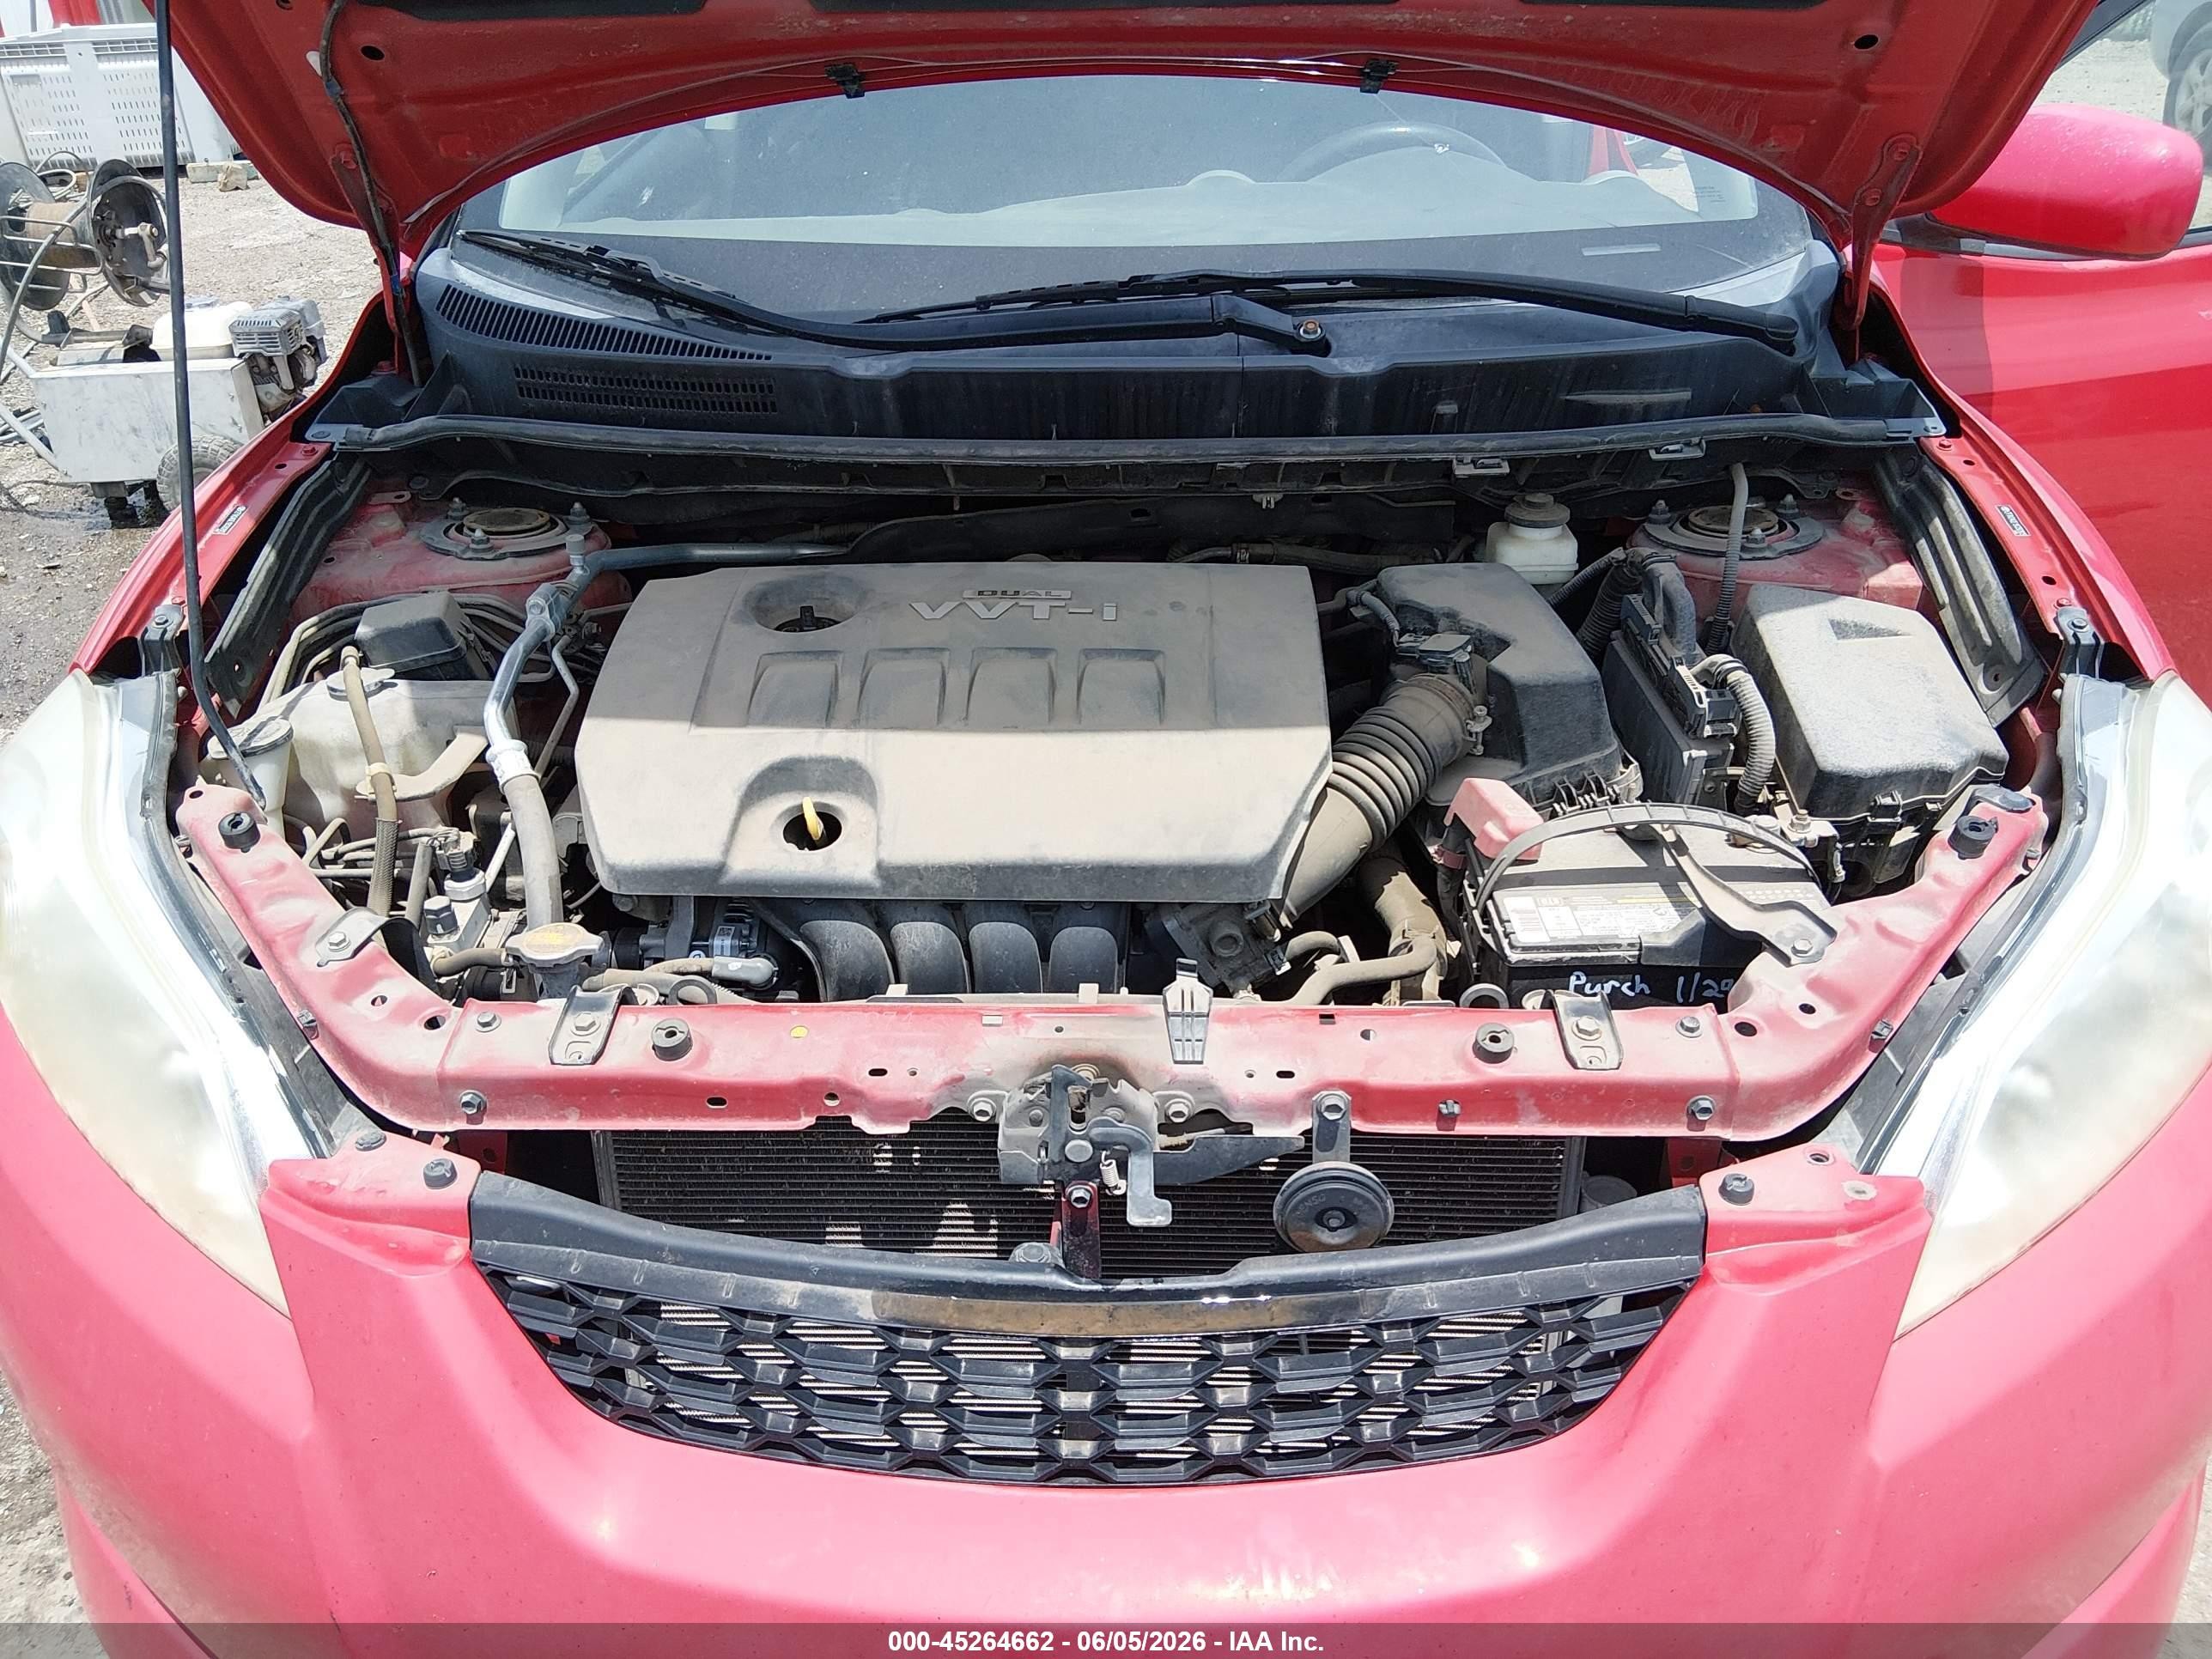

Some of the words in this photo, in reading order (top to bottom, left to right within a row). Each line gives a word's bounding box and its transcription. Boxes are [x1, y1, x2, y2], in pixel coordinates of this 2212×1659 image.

[975, 589, 1066, 599] DUAL
[909, 600, 1117, 620] VVT-i
[1570, 970, 1651, 997] Purch
